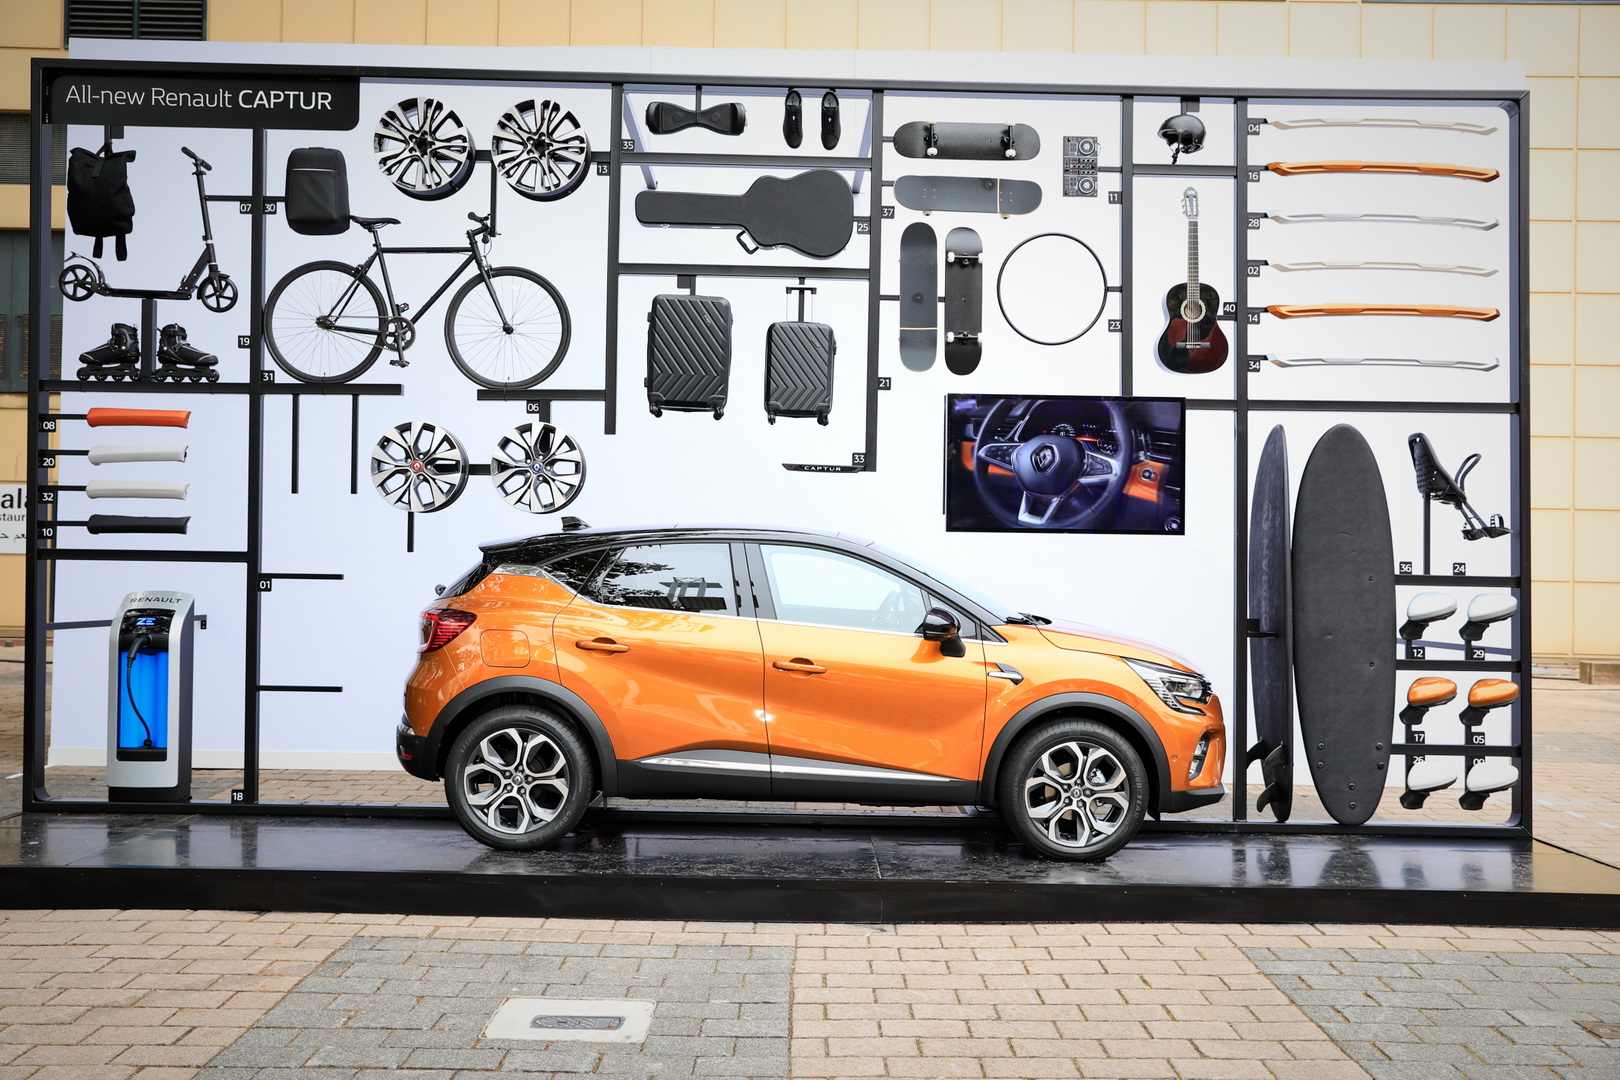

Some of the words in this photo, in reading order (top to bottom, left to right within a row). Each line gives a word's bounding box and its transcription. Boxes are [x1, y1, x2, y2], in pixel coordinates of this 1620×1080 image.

[65, 84, 145, 106] All-new
[151, 87, 233, 109] Renault
[237, 90, 332, 111] CAPTUR
[1248, 125, 1259, 133] 04
[622, 141, 634, 150] 35
[598, 165, 608, 174] 13
[1248, 172, 1259, 180] 16
[1109, 193, 1118, 201] 11
[240, 204, 252, 212] 07
[265, 204, 276, 212] 30
[882, 208, 894, 216] 37
[1248, 219, 1259, 227] 28
[858, 224, 869, 232] 25
[1248, 267, 1259, 275] 02
[1223, 304, 1235, 313] 40
[1110, 321, 1120, 330] 23
[239, 337, 250, 345] 19
[1248, 361, 1260, 370] 34
[263, 372, 274, 381] 31
[879, 379, 890, 387] 21
[527, 403, 539, 411] 06
[43, 422, 55, 430] 08
[43, 458, 55, 466] 20
[854, 455, 864, 463] 33
[0, 488, 27, 509] al
[43, 493, 53, 501] 32
[43, 528, 53, 536] 10
[1400, 564, 1412, 572] 36
[1454, 564, 1465, 573] 24
[260, 581, 271, 589] 01
[1413, 649, 1423, 657] 12
[1473, 650, 1484, 658] 29
[1414, 734, 1425, 742] 17
[1473, 735, 1485, 744] 05
[233, 792, 243, 800] 18
